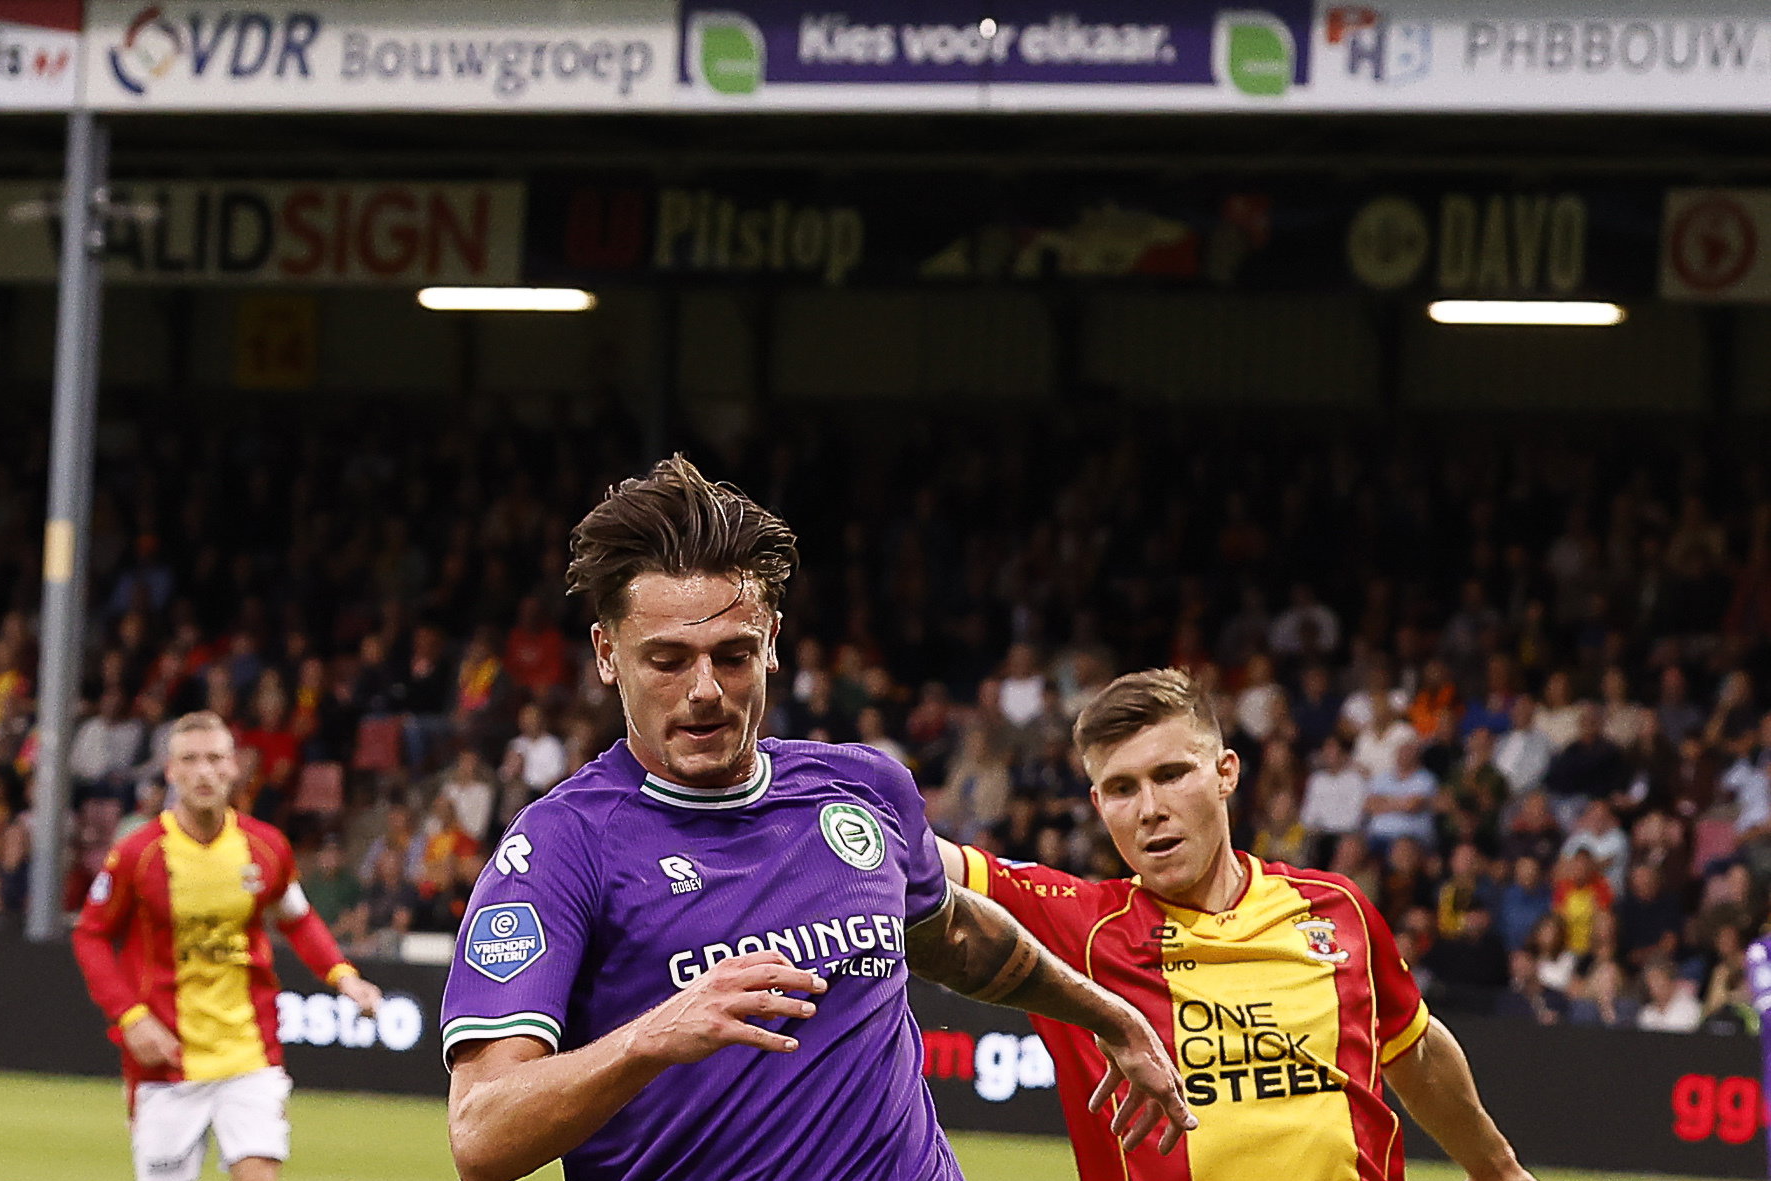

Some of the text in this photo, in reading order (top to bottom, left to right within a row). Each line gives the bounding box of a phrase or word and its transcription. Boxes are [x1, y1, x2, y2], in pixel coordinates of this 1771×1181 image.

[188, 12, 655, 98] VDR Bouwgroep
[798, 15, 1178, 64] Kies voor elkaar.
[1436, 190, 1590, 292] DAVO
[670, 877, 703, 895] ROBEY
[473, 938, 536, 955] VRIENDEN
[1178, 999, 1278, 1032] ONE
[1180, 1031, 1317, 1070] CLICK
[1184, 1062, 1343, 1107] STEEL
